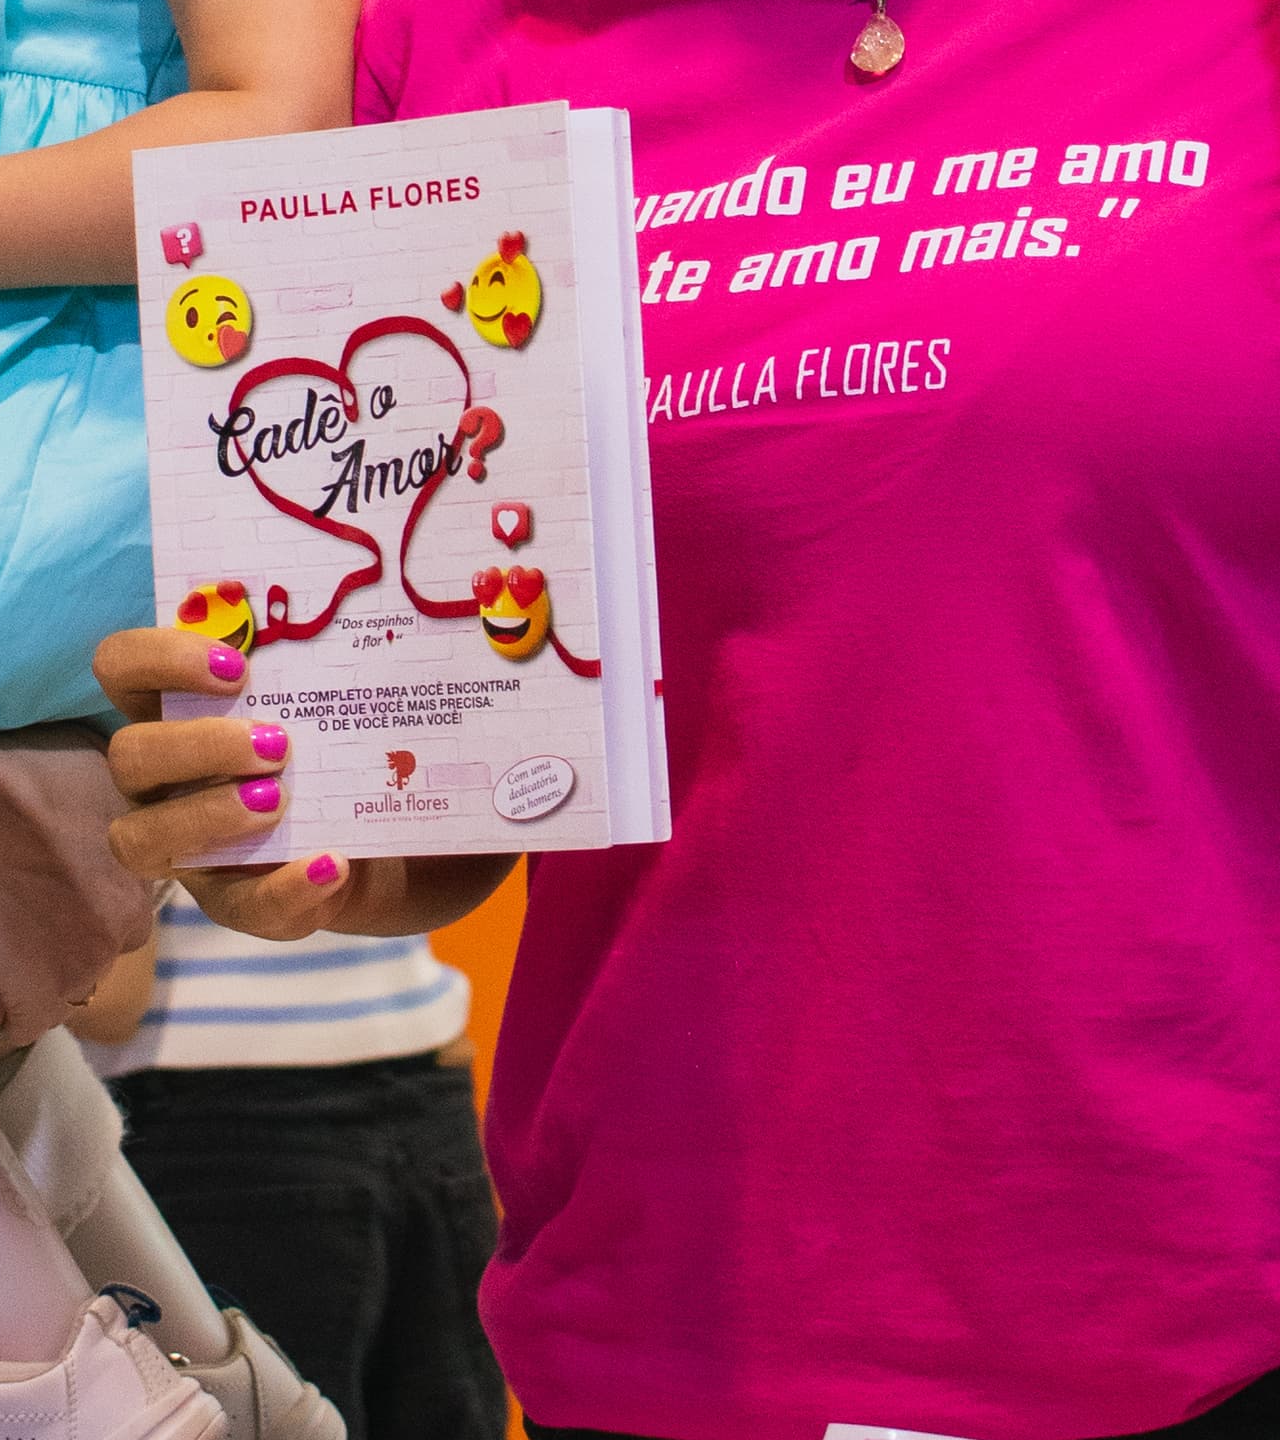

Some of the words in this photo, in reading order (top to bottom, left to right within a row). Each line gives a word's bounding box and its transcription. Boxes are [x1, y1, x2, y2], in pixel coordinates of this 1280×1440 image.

[240, 190, 358, 224] PAULLA
[369, 176, 481, 211] FLORES
[632, 155, 807, 233] uando
[832, 159, 914, 209] eu
[932, 146, 1037, 197] me
[1057, 139, 1210, 187] amo
[641, 250, 711, 304] te
[728, 235, 879, 294] amo
[796, 338, 951, 401] FLORES
[208, 388, 347, 477] Cadê
[371, 384, 397, 419] o
[366, 613, 414, 631] espinhos
[246, 695, 256, 707] O
[261, 693, 294, 706] GUIA
[298, 688, 371, 704] COMPLETO
[376, 686, 408, 699] PARA
[410, 680, 445, 697] VOCÊ
[447, 679, 520, 695] ENCONTRAR
[280, 708, 290, 719] O
[294, 705, 335, 719] AMOR
[338, 704, 367, 717] QUE
[370, 697, 404, 714] VOCÊ
[407, 700, 437, 712] MAIS
[439, 697, 494, 710] PRECISA:
[318, 720, 328, 732] O
[332, 719, 350, 731] DE
[354, 712, 389, 730] VOCÊ
[392, 715, 425, 728] PARA
[426, 709, 463, 726] VOCÊ!
[507, 771, 528, 786] Com
[531, 760, 552, 776] uma
[508, 773, 558, 801] dedicatória
[354, 794, 402, 818] paulla
[405, 793, 449, 812] flores
[511, 804, 527, 817] aos
